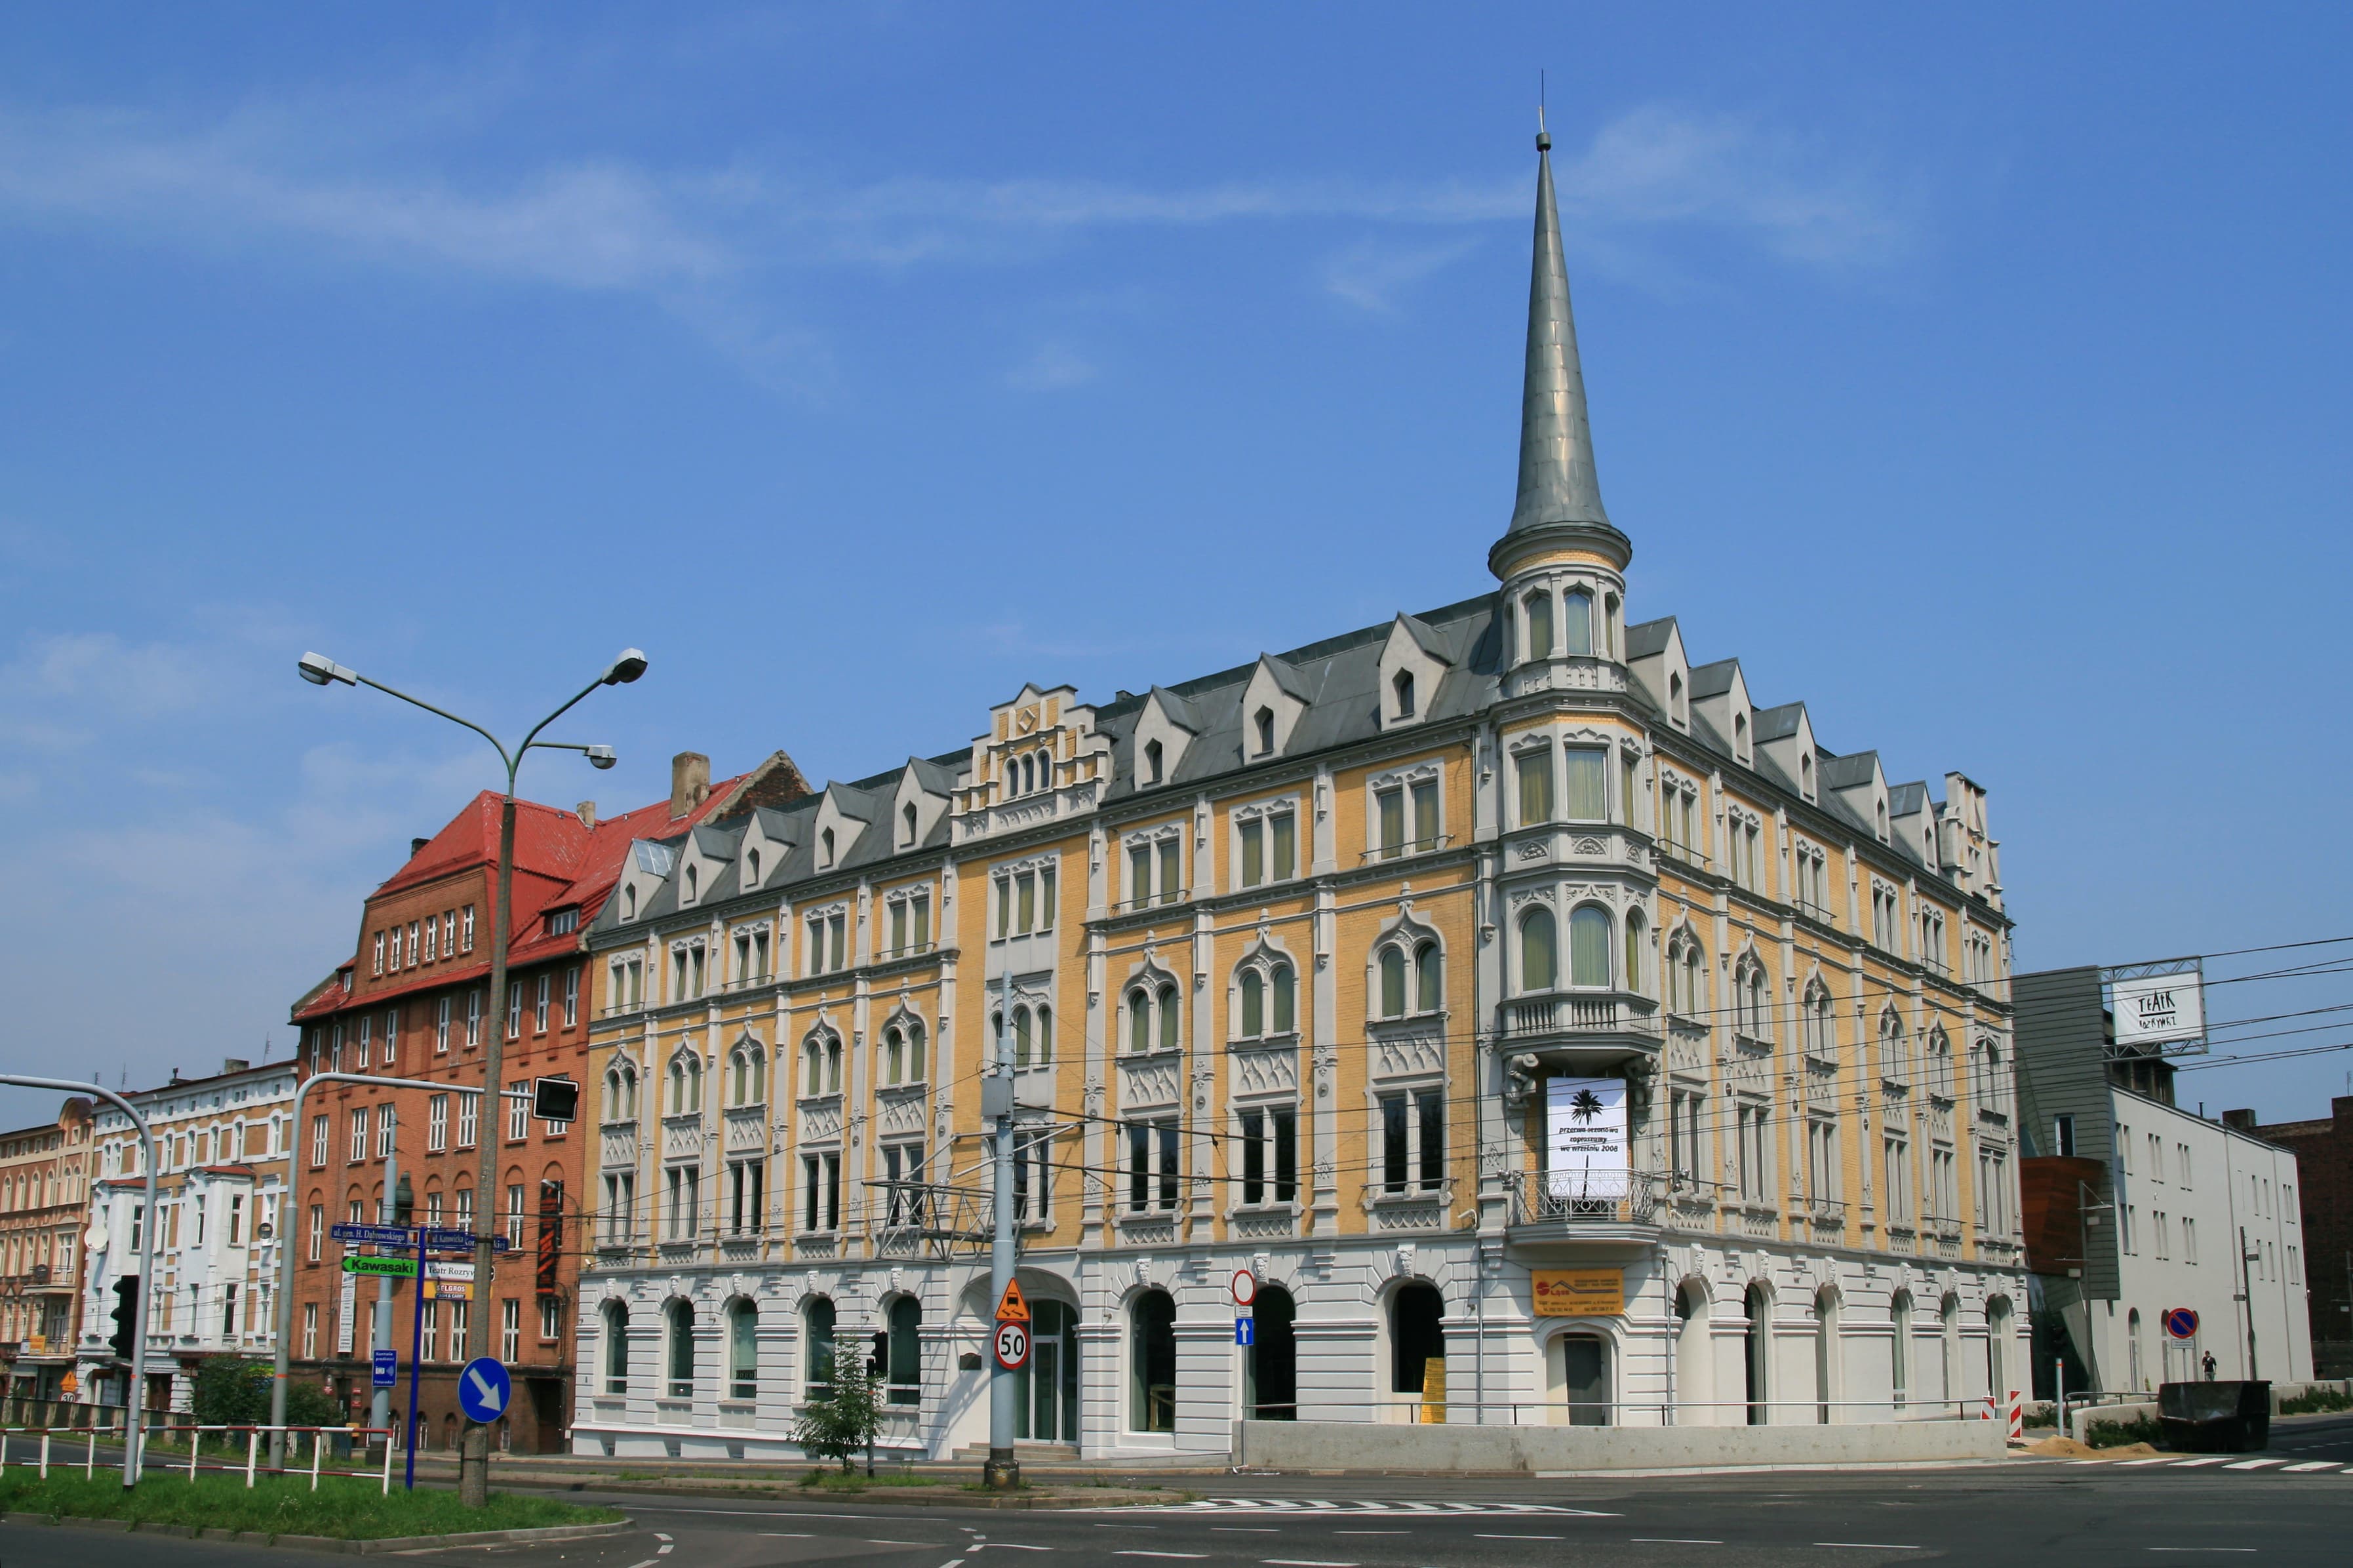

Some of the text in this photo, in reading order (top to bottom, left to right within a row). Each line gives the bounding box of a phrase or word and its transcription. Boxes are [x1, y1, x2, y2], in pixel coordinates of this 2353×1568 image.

[2139, 990, 2175, 1012] TEATR
[356, 1229, 363, 1238] H.
[364, 1230, 405, 1243] Dąbrowskiego
[351, 1259, 414, 1274] Kawasaki
[429, 1266, 446, 1274] Teatr
[1000, 1334, 1024, 1356] 50
